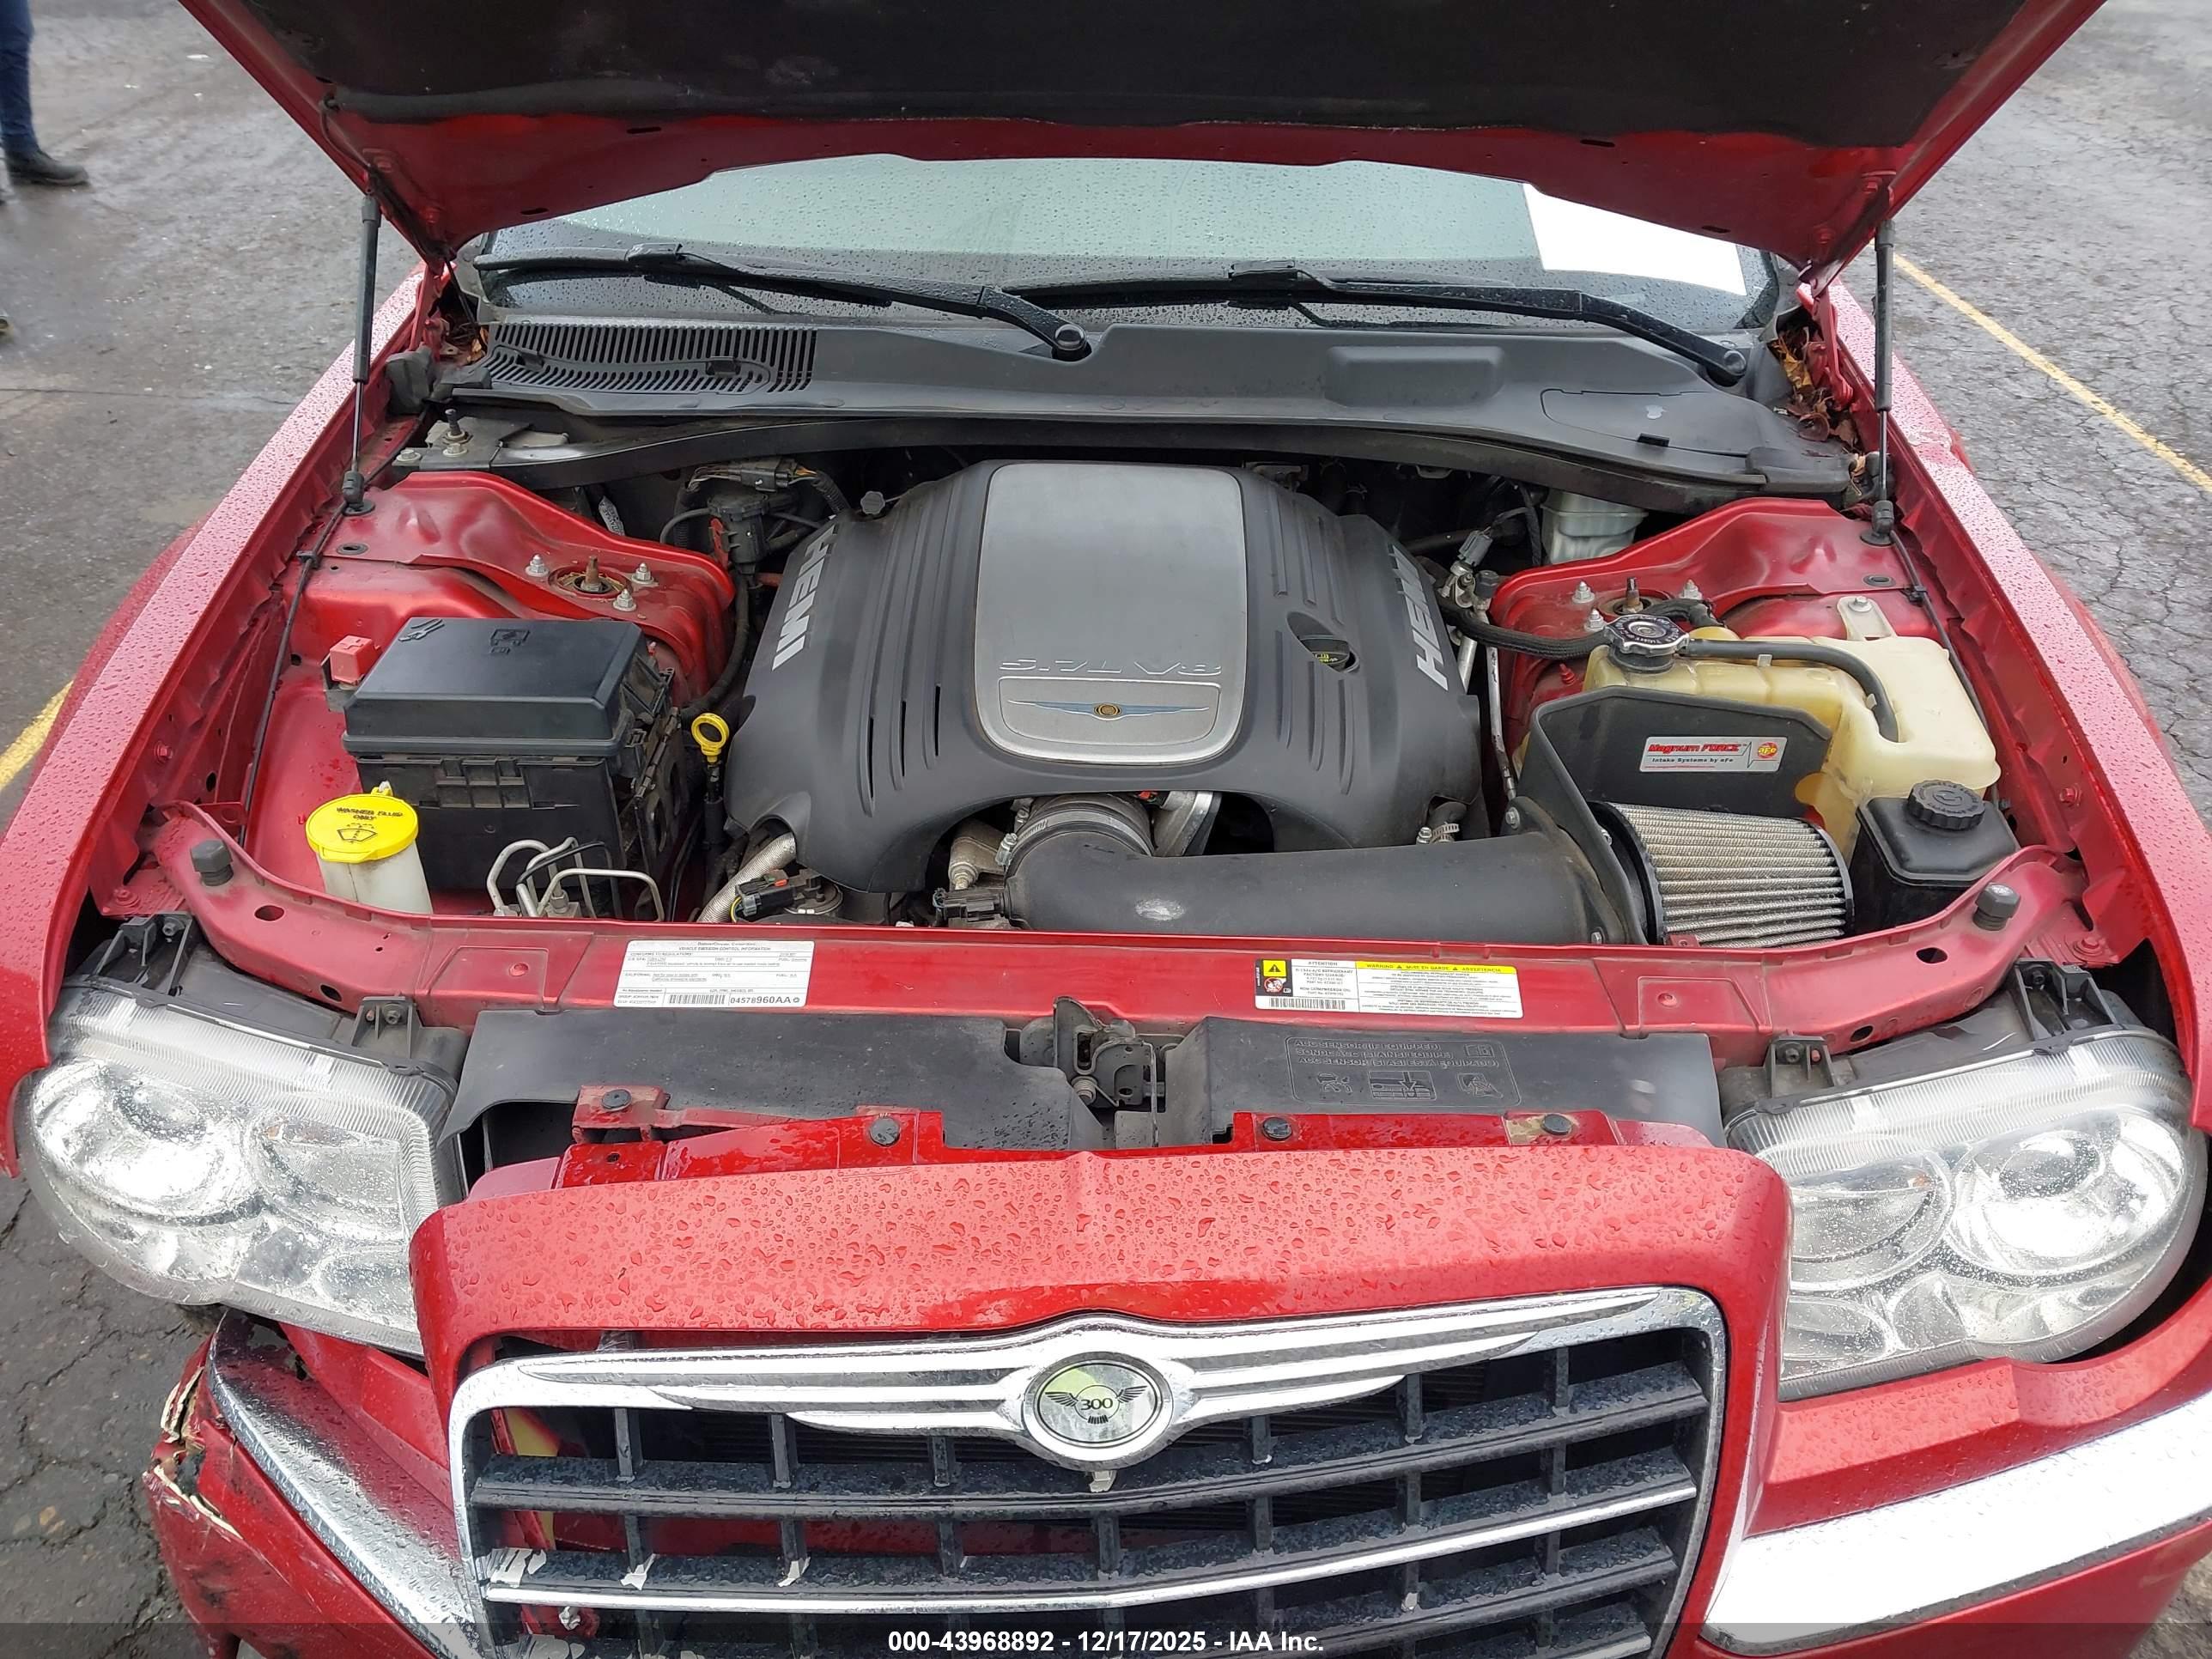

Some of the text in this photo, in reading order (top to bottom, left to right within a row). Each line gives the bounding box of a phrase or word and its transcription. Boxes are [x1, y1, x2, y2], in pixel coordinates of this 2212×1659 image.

[772, 523, 838, 672] HEMI
[1647, 744, 1700, 754] Magnum
[1080, 1397, 1114, 1411] 300
